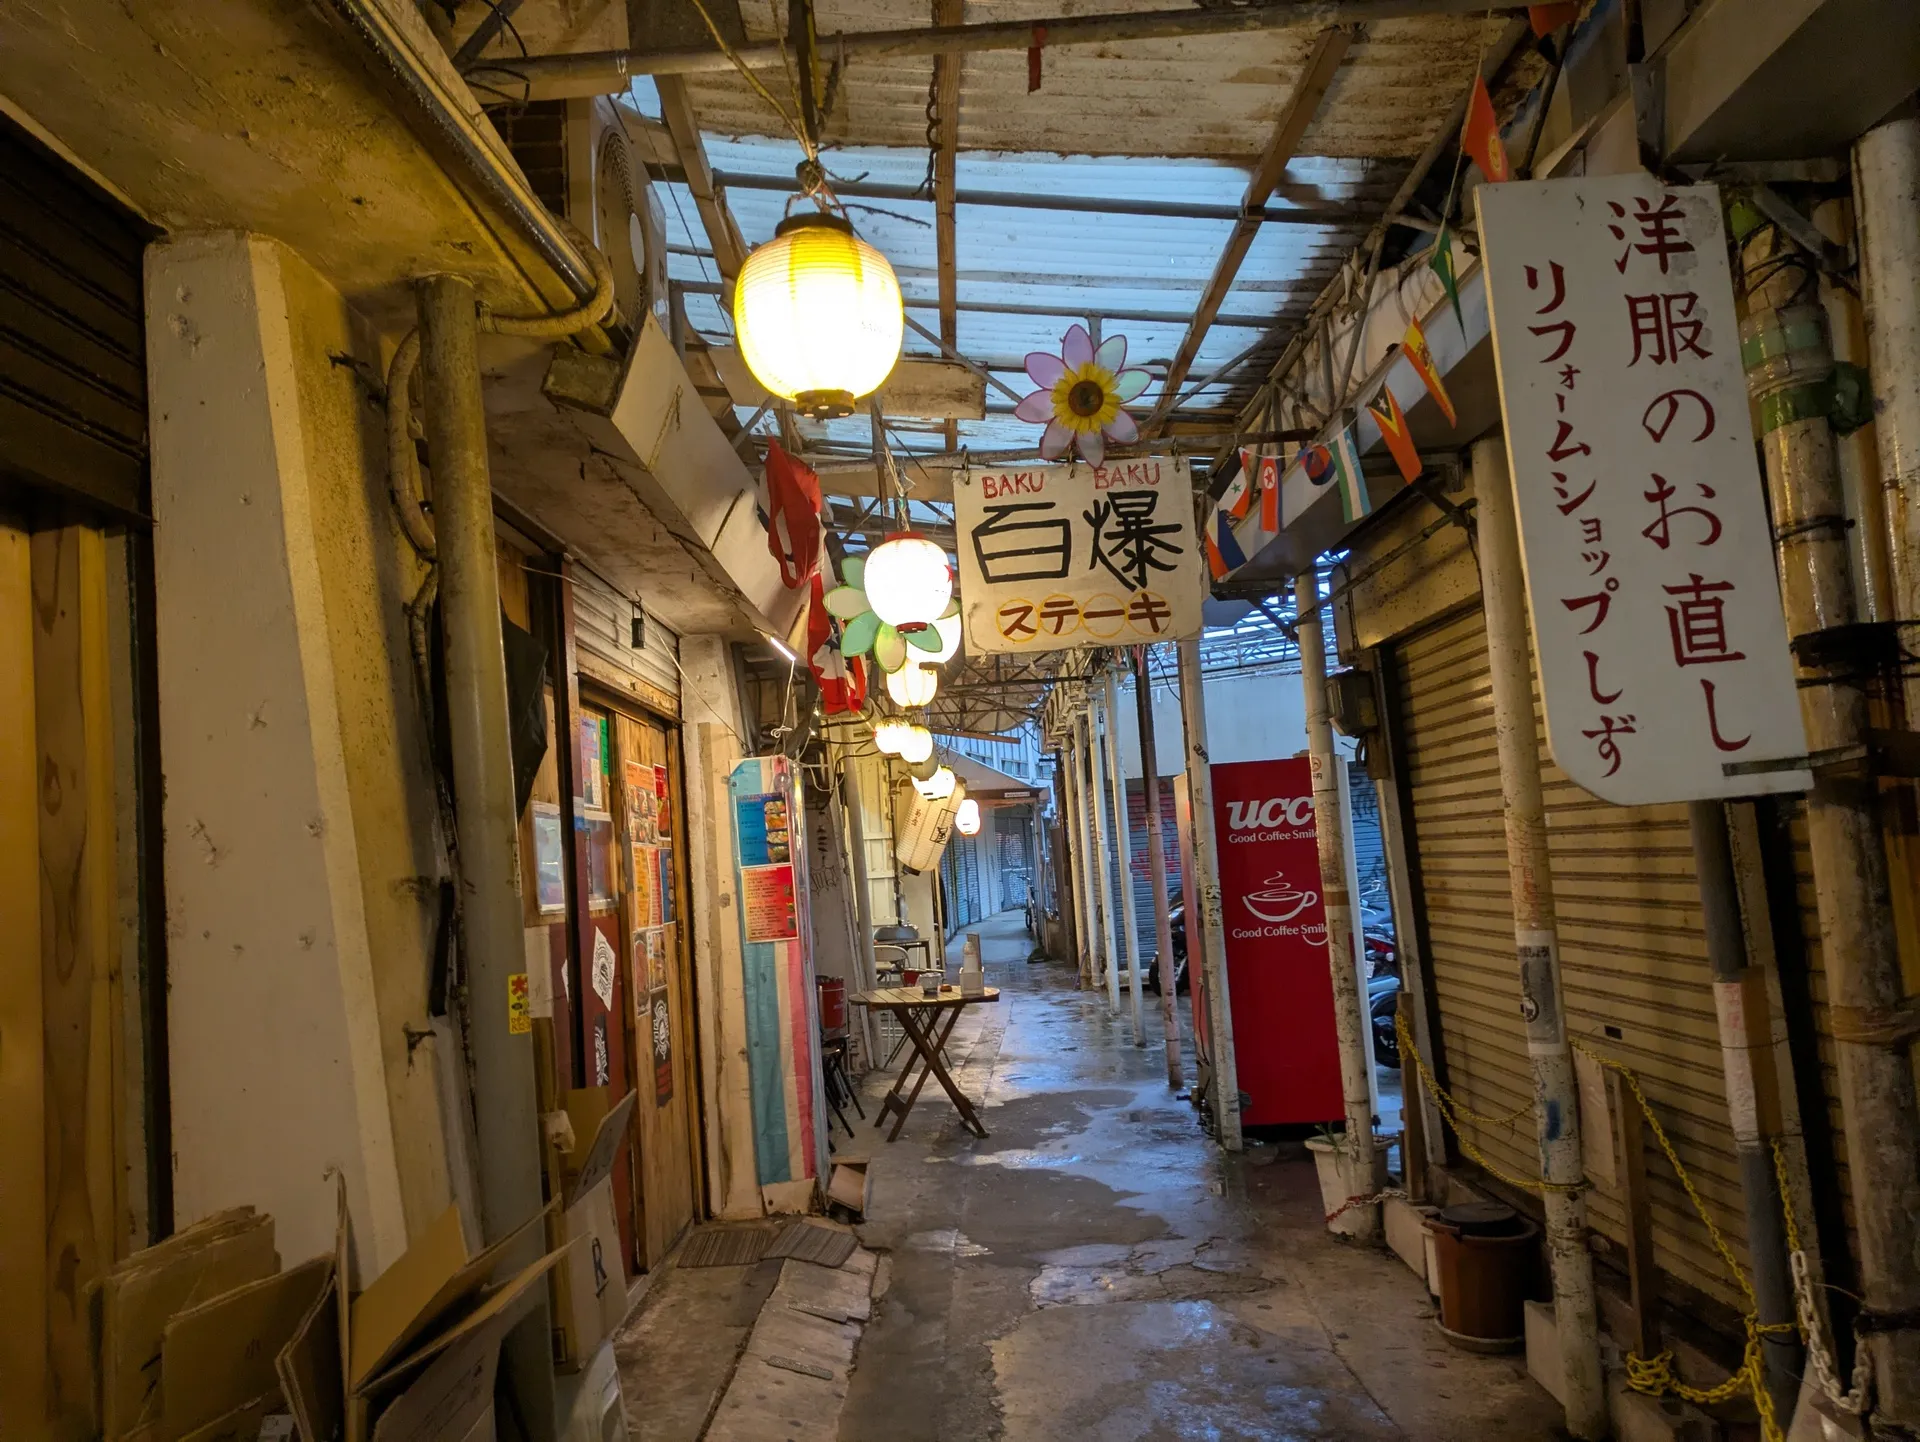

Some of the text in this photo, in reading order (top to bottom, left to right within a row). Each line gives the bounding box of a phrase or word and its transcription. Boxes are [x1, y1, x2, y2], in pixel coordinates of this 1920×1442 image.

[982, 463, 1160, 499] BAKU BAKU
[1608, 196, 1752, 753] 洋服のお直し
[1523, 259, 1637, 777] リフォームショップしず
[1000, 592, 1171, 636] ステーキ
[1229, 832, 1257, 844] Good
[1258, 829, 1291, 843] Coffee
[1232, 928, 1262, 940] Good
[1263, 925, 1299, 938] Coffee
